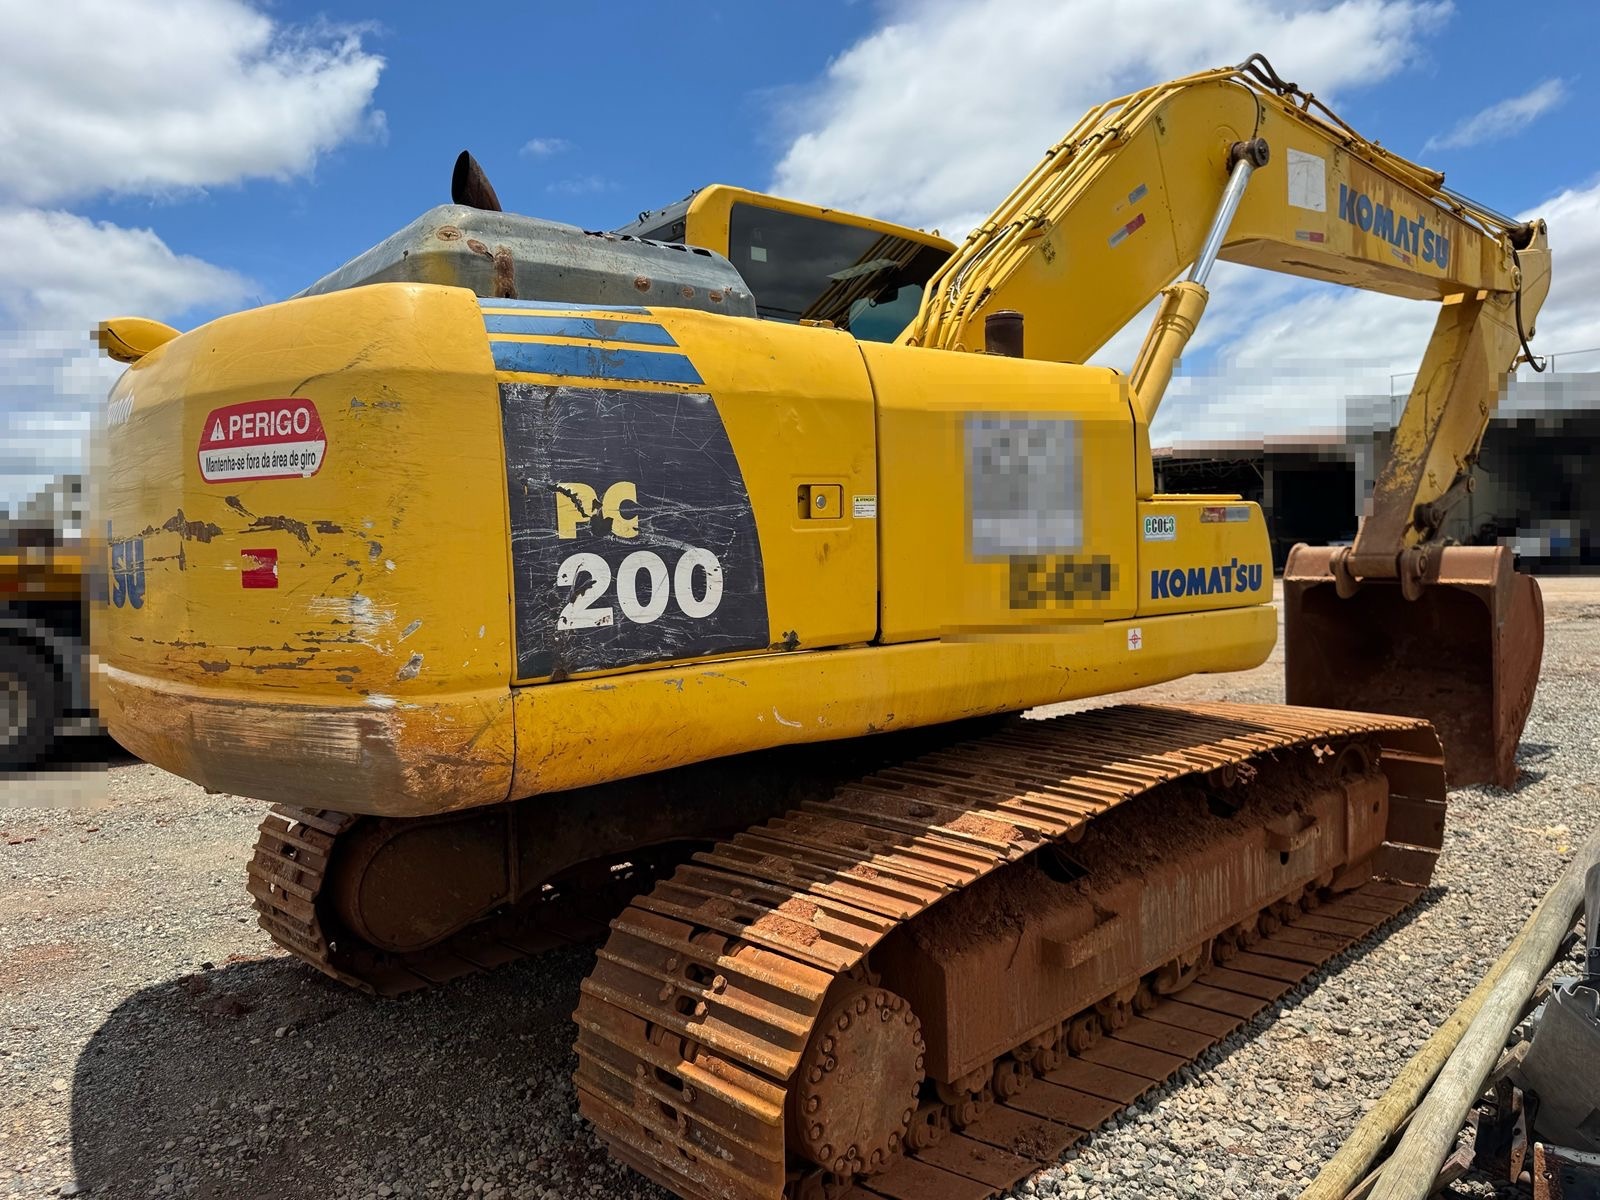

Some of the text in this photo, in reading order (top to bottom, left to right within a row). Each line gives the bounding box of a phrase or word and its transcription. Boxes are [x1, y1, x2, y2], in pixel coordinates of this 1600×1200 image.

[1339, 183, 1449, 270] KOMATSU
[229, 407, 310, 440] PERIGO
[206, 449, 316, 473] Mantenha-se fora da área de giro
[555, 481, 639, 539] PC
[1146, 517, 1174, 533] ecot3
[557, 547, 723, 631] 200
[1151, 557, 1262, 599] KOMATSU
